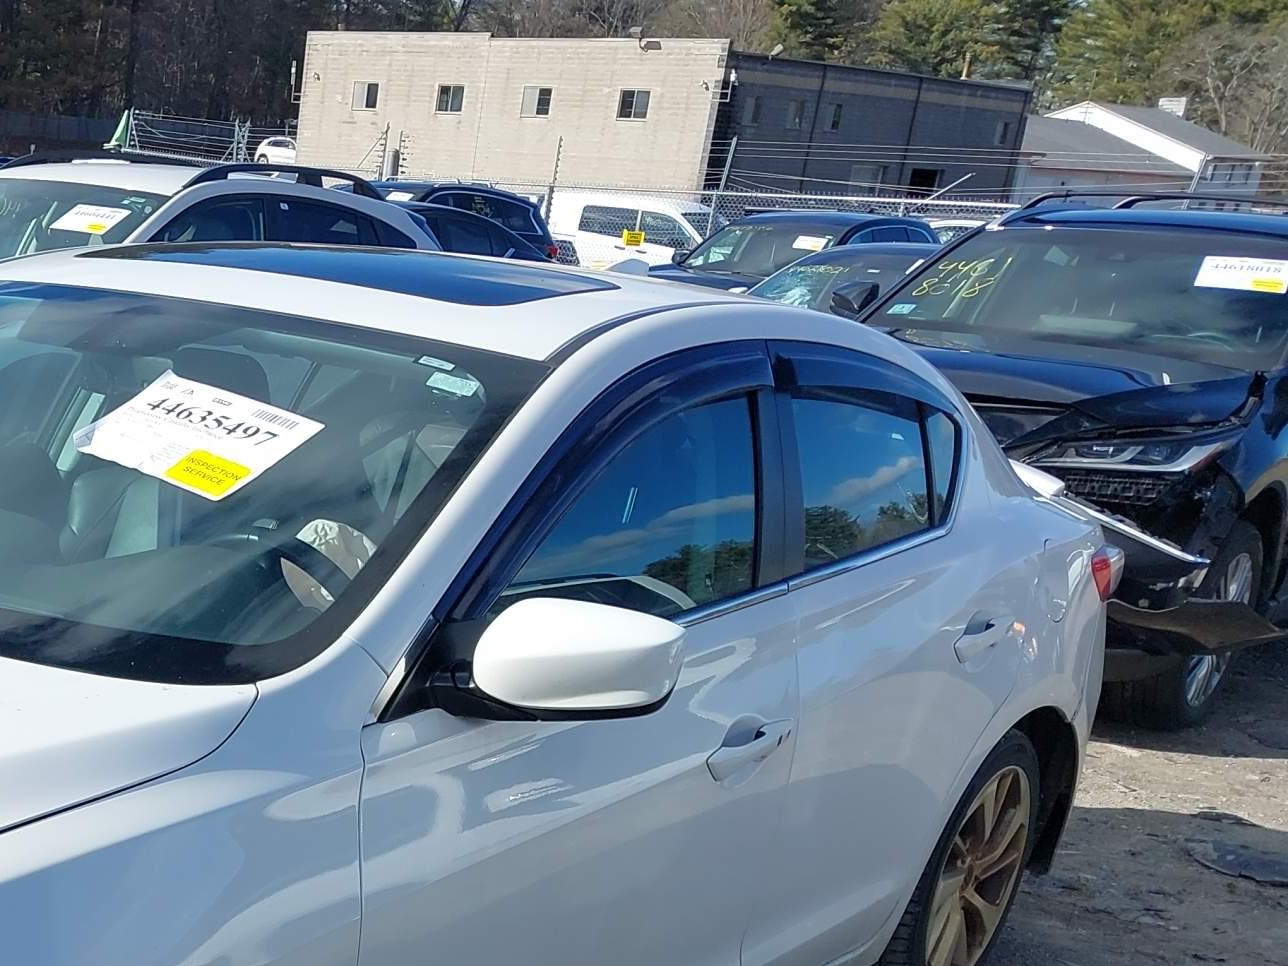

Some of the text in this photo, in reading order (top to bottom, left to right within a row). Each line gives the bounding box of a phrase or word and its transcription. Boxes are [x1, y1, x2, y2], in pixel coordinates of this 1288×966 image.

[146, 397, 280, 448] 44635497
[183, 465, 227, 486] SERVICE
[185, 455, 242, 481] INSPECTION
